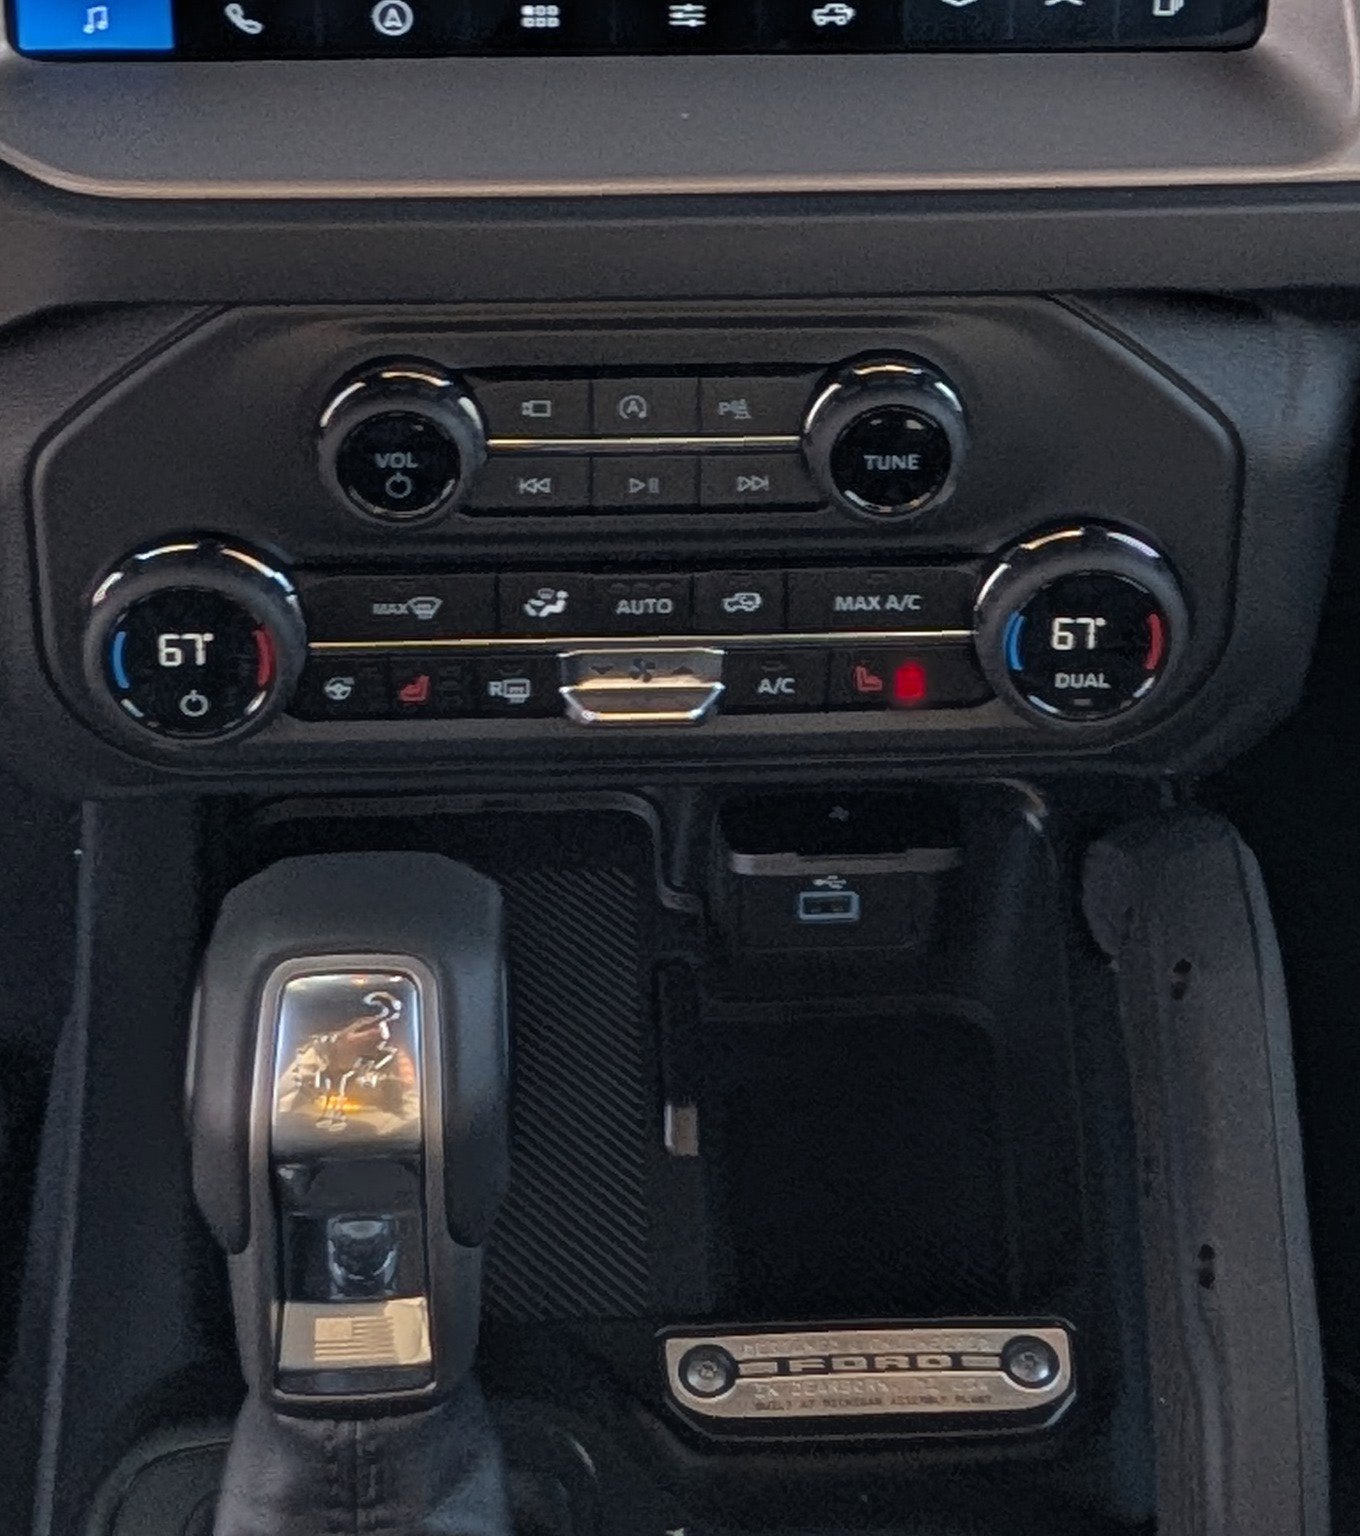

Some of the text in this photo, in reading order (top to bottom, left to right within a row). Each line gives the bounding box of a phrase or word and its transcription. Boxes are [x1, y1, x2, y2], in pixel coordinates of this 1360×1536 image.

[375, 453, 419, 469] VOL
[864, 454, 919, 470] TUNE
[373, 602, 407, 615] MAX
[617, 597, 672, 615] AUTO
[835, 593, 922, 612] MAX A/C
[757, 677, 796, 695] A/C
[1055, 672, 1110, 689] DUAL
